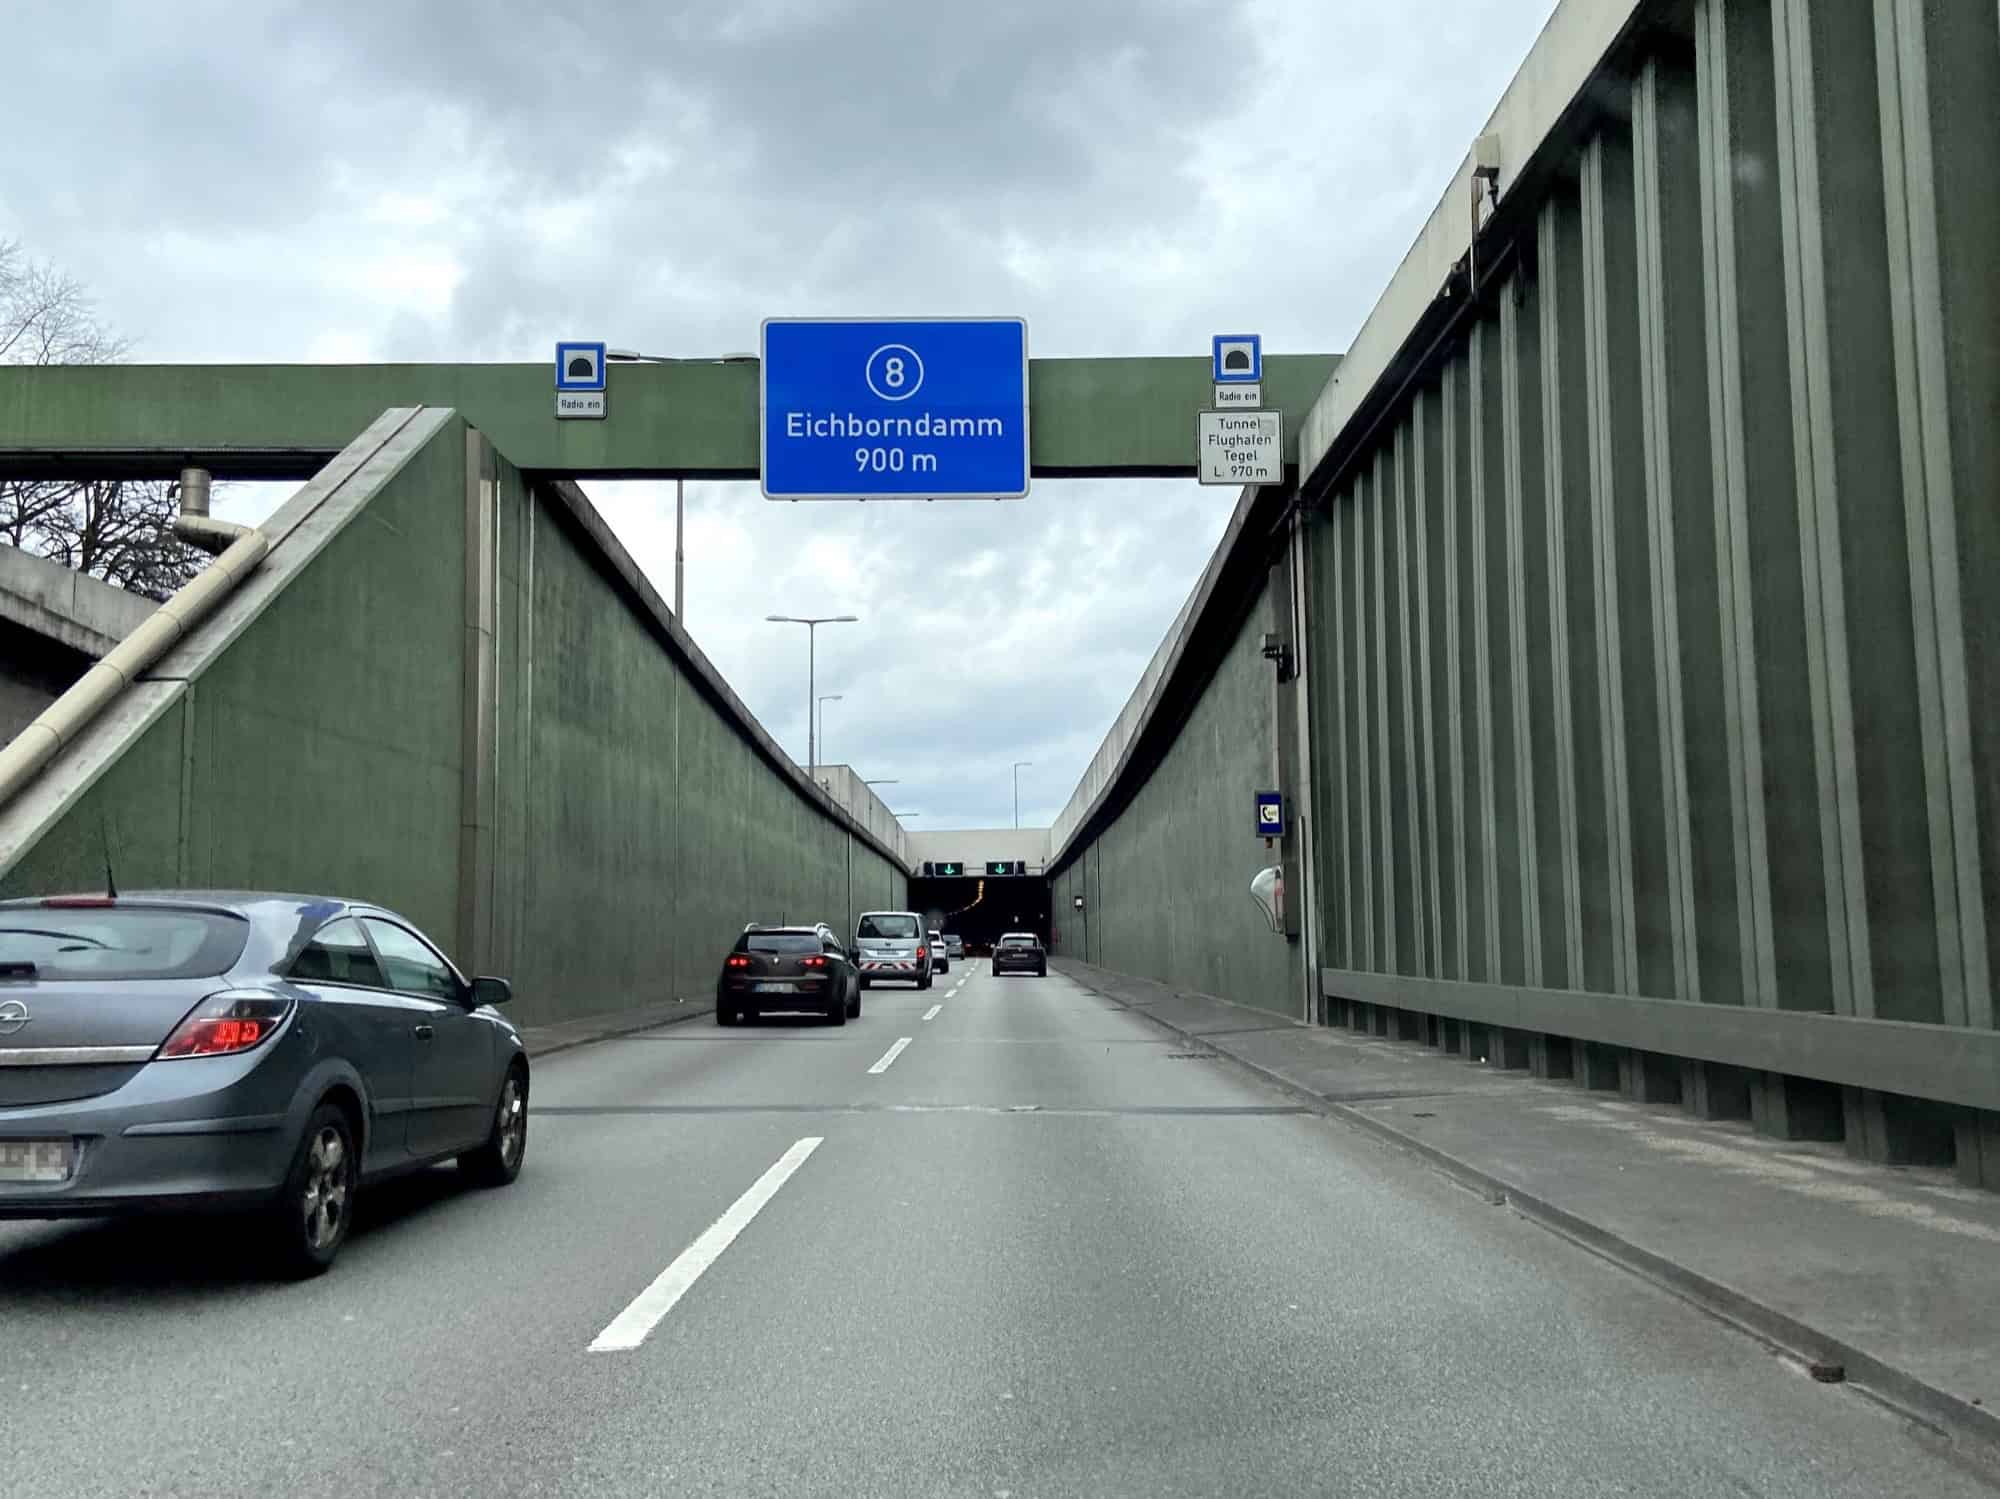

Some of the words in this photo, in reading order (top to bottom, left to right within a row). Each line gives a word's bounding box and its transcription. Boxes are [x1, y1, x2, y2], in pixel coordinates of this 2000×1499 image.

[886, 358, 904, 387] 8
[1220, 391, 1241, 401] Radio
[561, 399, 584, 409] Radio
[588, 399, 600, 409] ein
[787, 413, 1003, 437] Eichborndamm
[1218, 418, 1260, 430] Tunnel
[1208, 434, 1271, 448] Flughafen
[856, 448, 904, 472] 900
[912, 454, 937, 472] m
[1224, 450, 1257, 463] Tegel
[1231, 465, 1253, 477] 970
[1256, 468, 1268, 477] m
